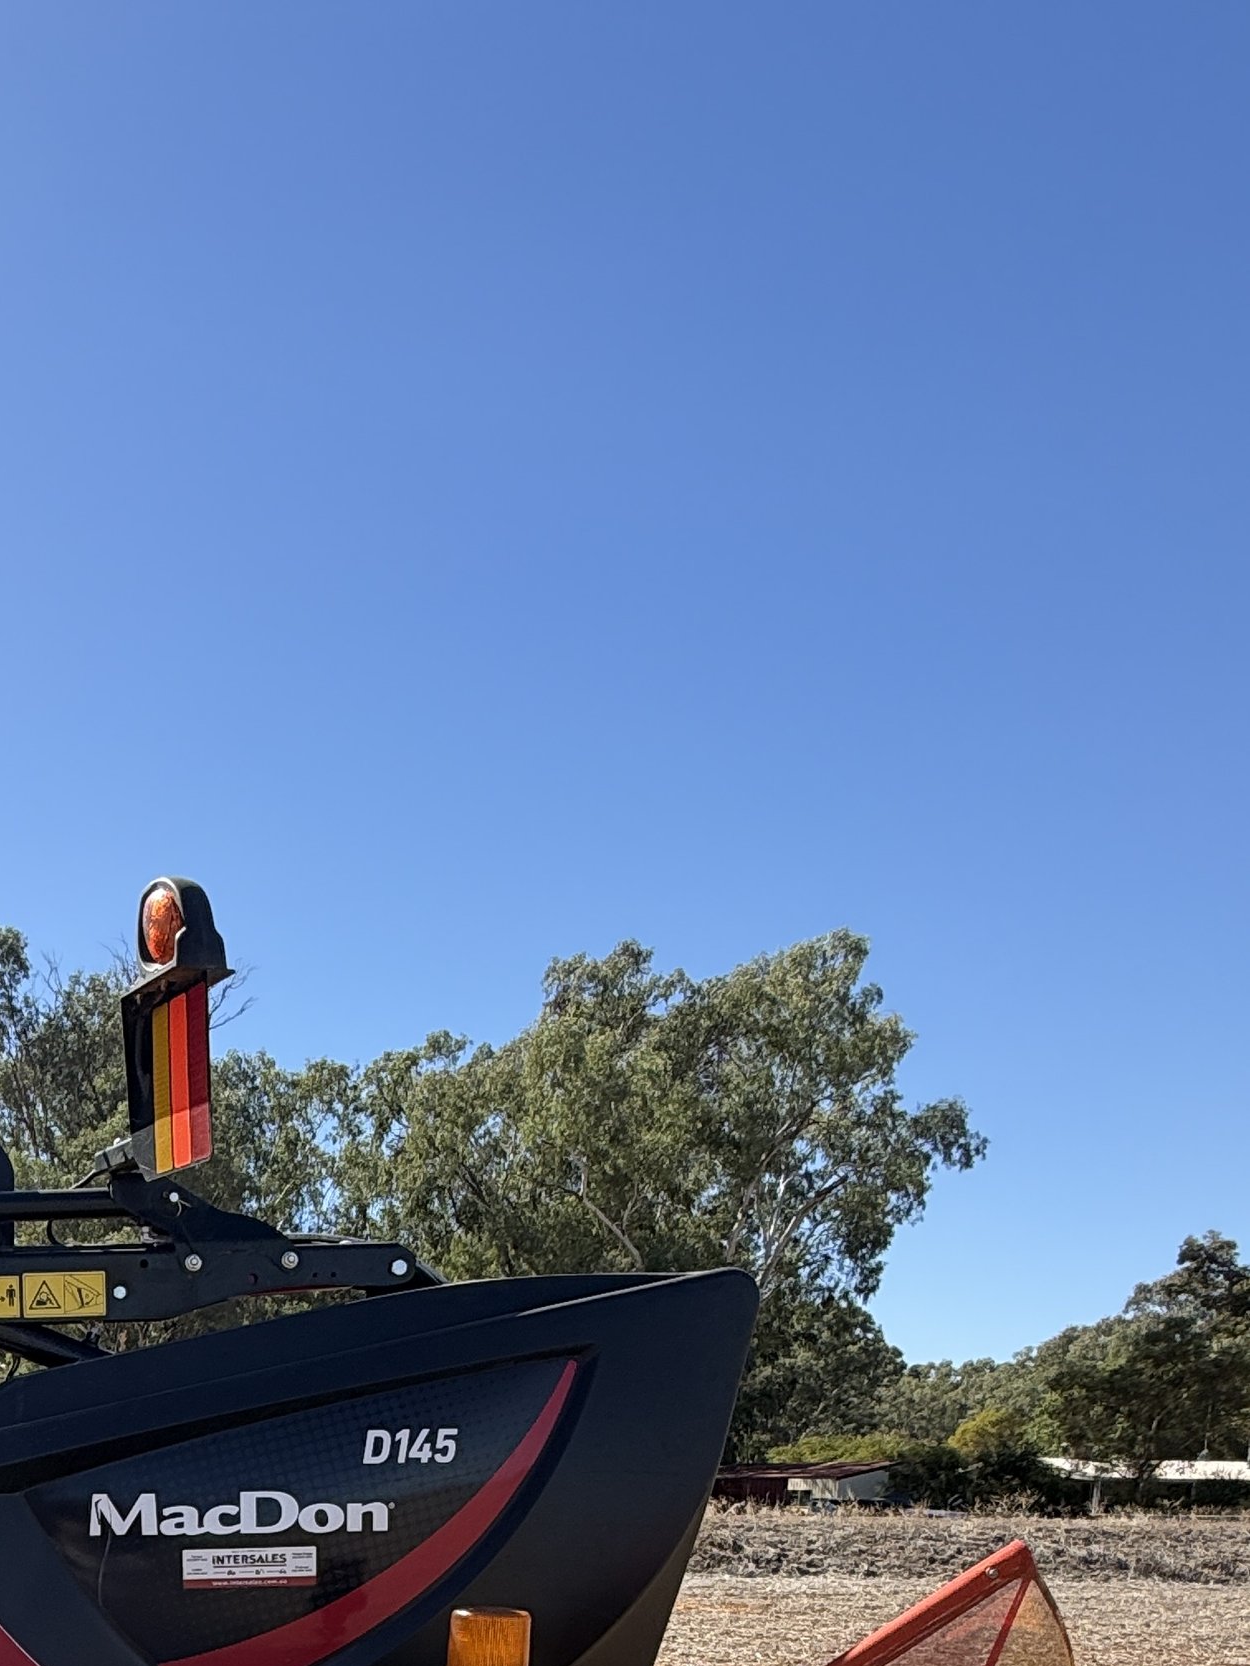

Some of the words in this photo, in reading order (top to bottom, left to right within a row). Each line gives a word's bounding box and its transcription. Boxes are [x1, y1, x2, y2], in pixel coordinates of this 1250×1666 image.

[362, 1428, 459, 1465] D145
[89, 1490, 389, 1537] MacDon
[211, 1553, 287, 1566] INTERSALES
